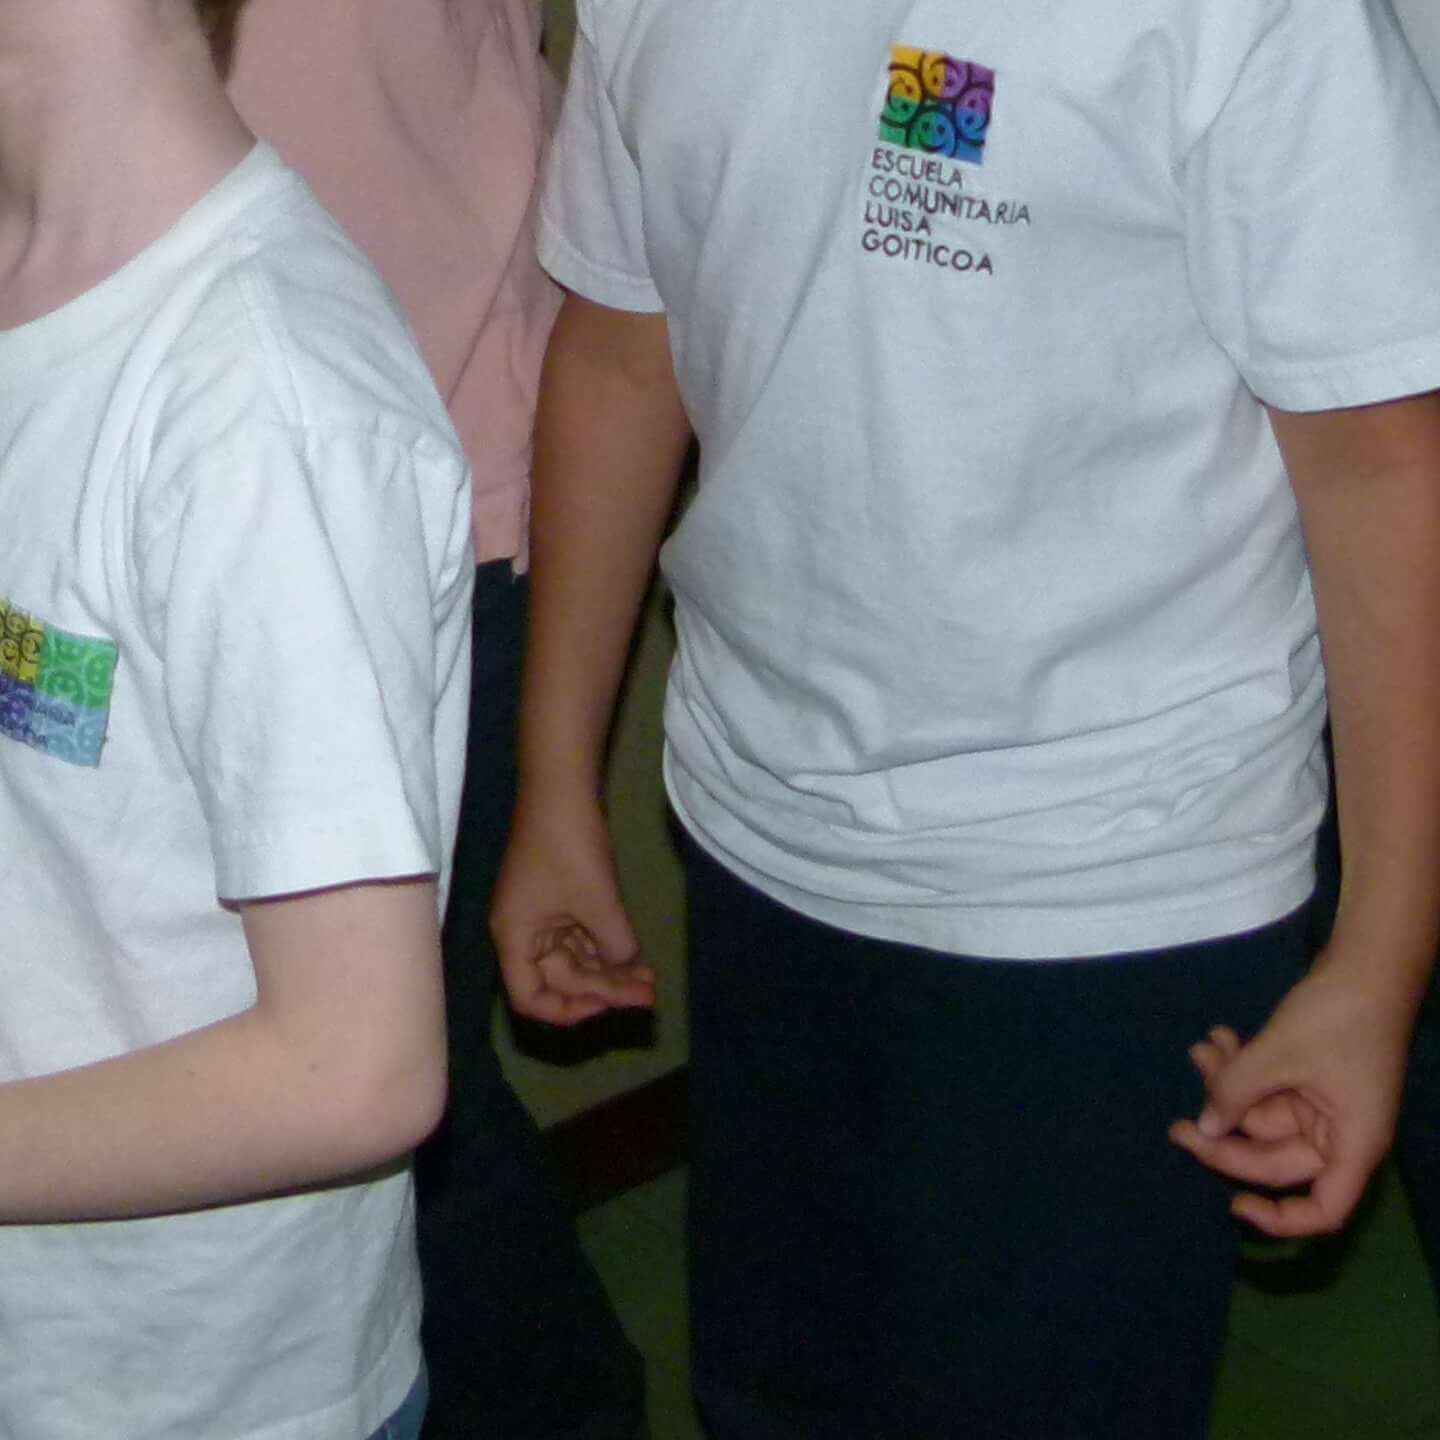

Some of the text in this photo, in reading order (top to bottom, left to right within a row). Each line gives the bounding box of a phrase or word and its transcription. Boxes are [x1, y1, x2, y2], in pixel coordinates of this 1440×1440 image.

[872, 148, 963, 189] ESCUELA
[863, 200, 933, 237] LUISA
[868, 174, 1032, 226] COMUNITARIA
[861, 229, 994, 276] GOITICOA
